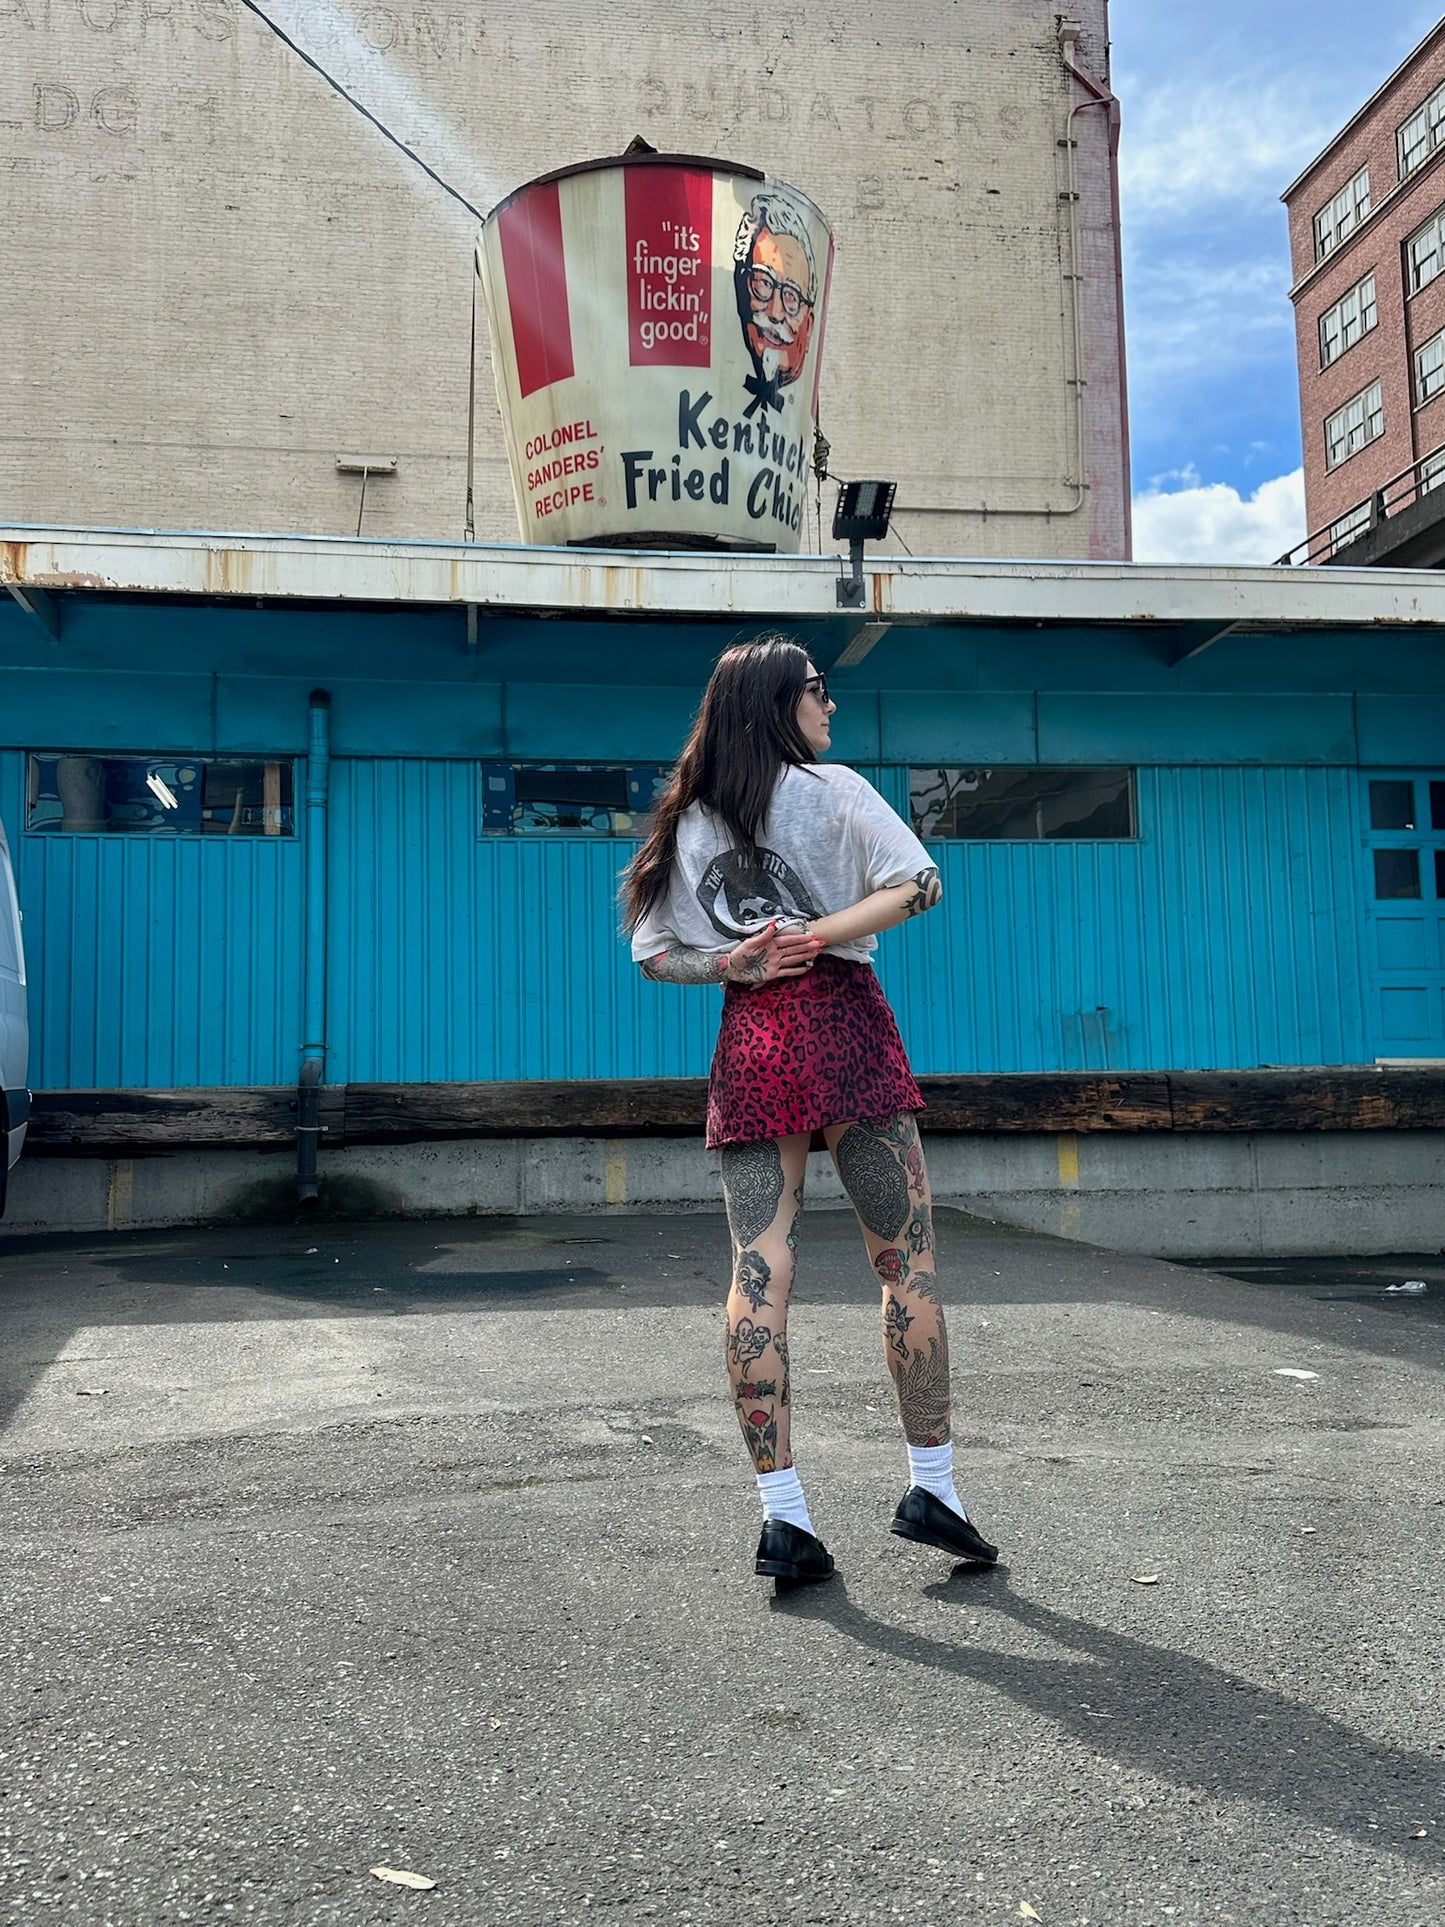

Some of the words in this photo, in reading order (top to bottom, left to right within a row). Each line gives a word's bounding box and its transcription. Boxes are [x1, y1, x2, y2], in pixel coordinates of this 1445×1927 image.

[662, 221, 701, 252] "it's
[633, 239, 701, 284] finger
[640, 278, 704, 311] lickin'
[639, 311, 709, 349] good"
[525, 420, 598, 460] COLONEL
[678, 389, 808, 484] Kentuck
[527, 445, 605, 491] SANDERS'
[535, 483, 595, 519] RECIPE
[620, 451, 730, 510] Fried
[747, 467, 804, 537] Chic
[704, 864, 724, 891] THE
